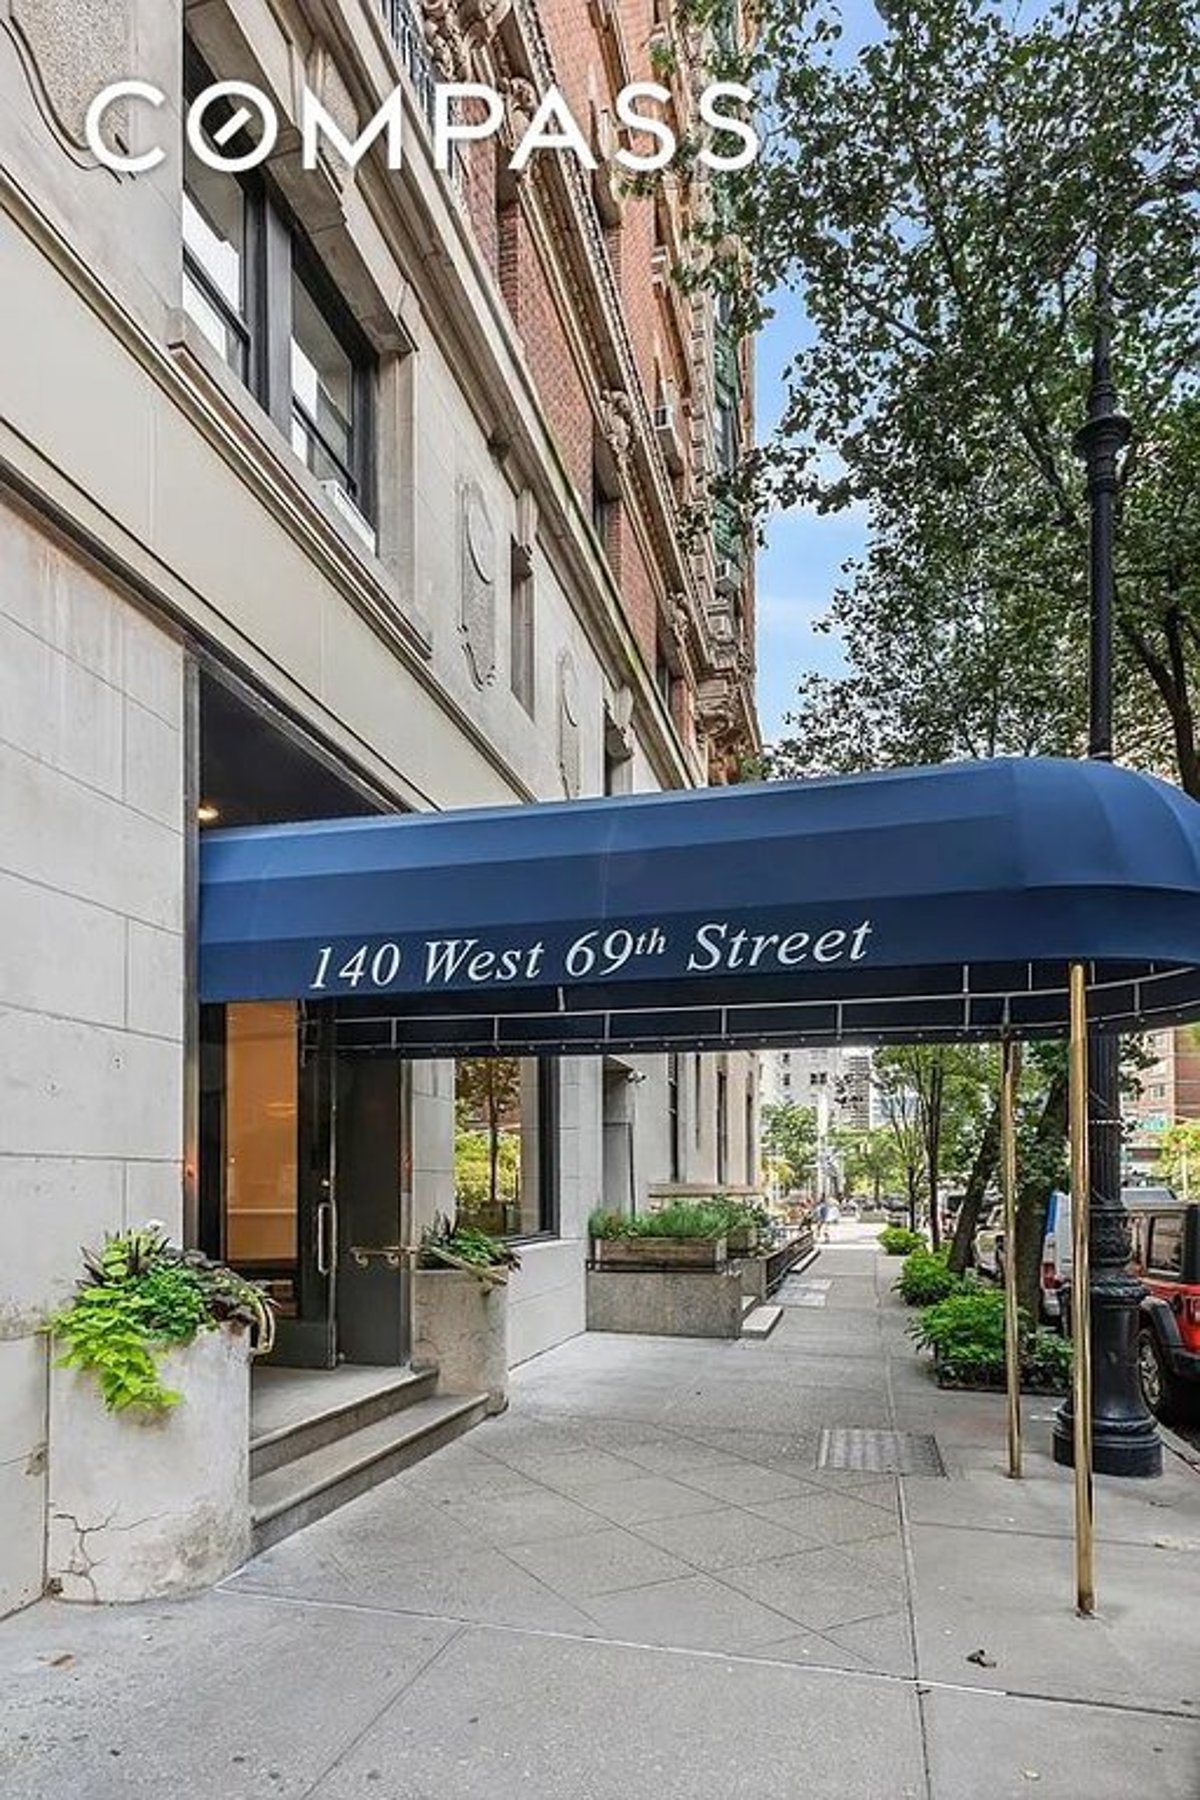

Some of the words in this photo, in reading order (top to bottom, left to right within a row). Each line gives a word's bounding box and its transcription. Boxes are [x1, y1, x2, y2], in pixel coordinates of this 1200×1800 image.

[310, 943, 401, 990] 140
[424, 938, 545, 983] West
[564, 927, 668, 977] 69th
[685, 920, 874, 971] Street
